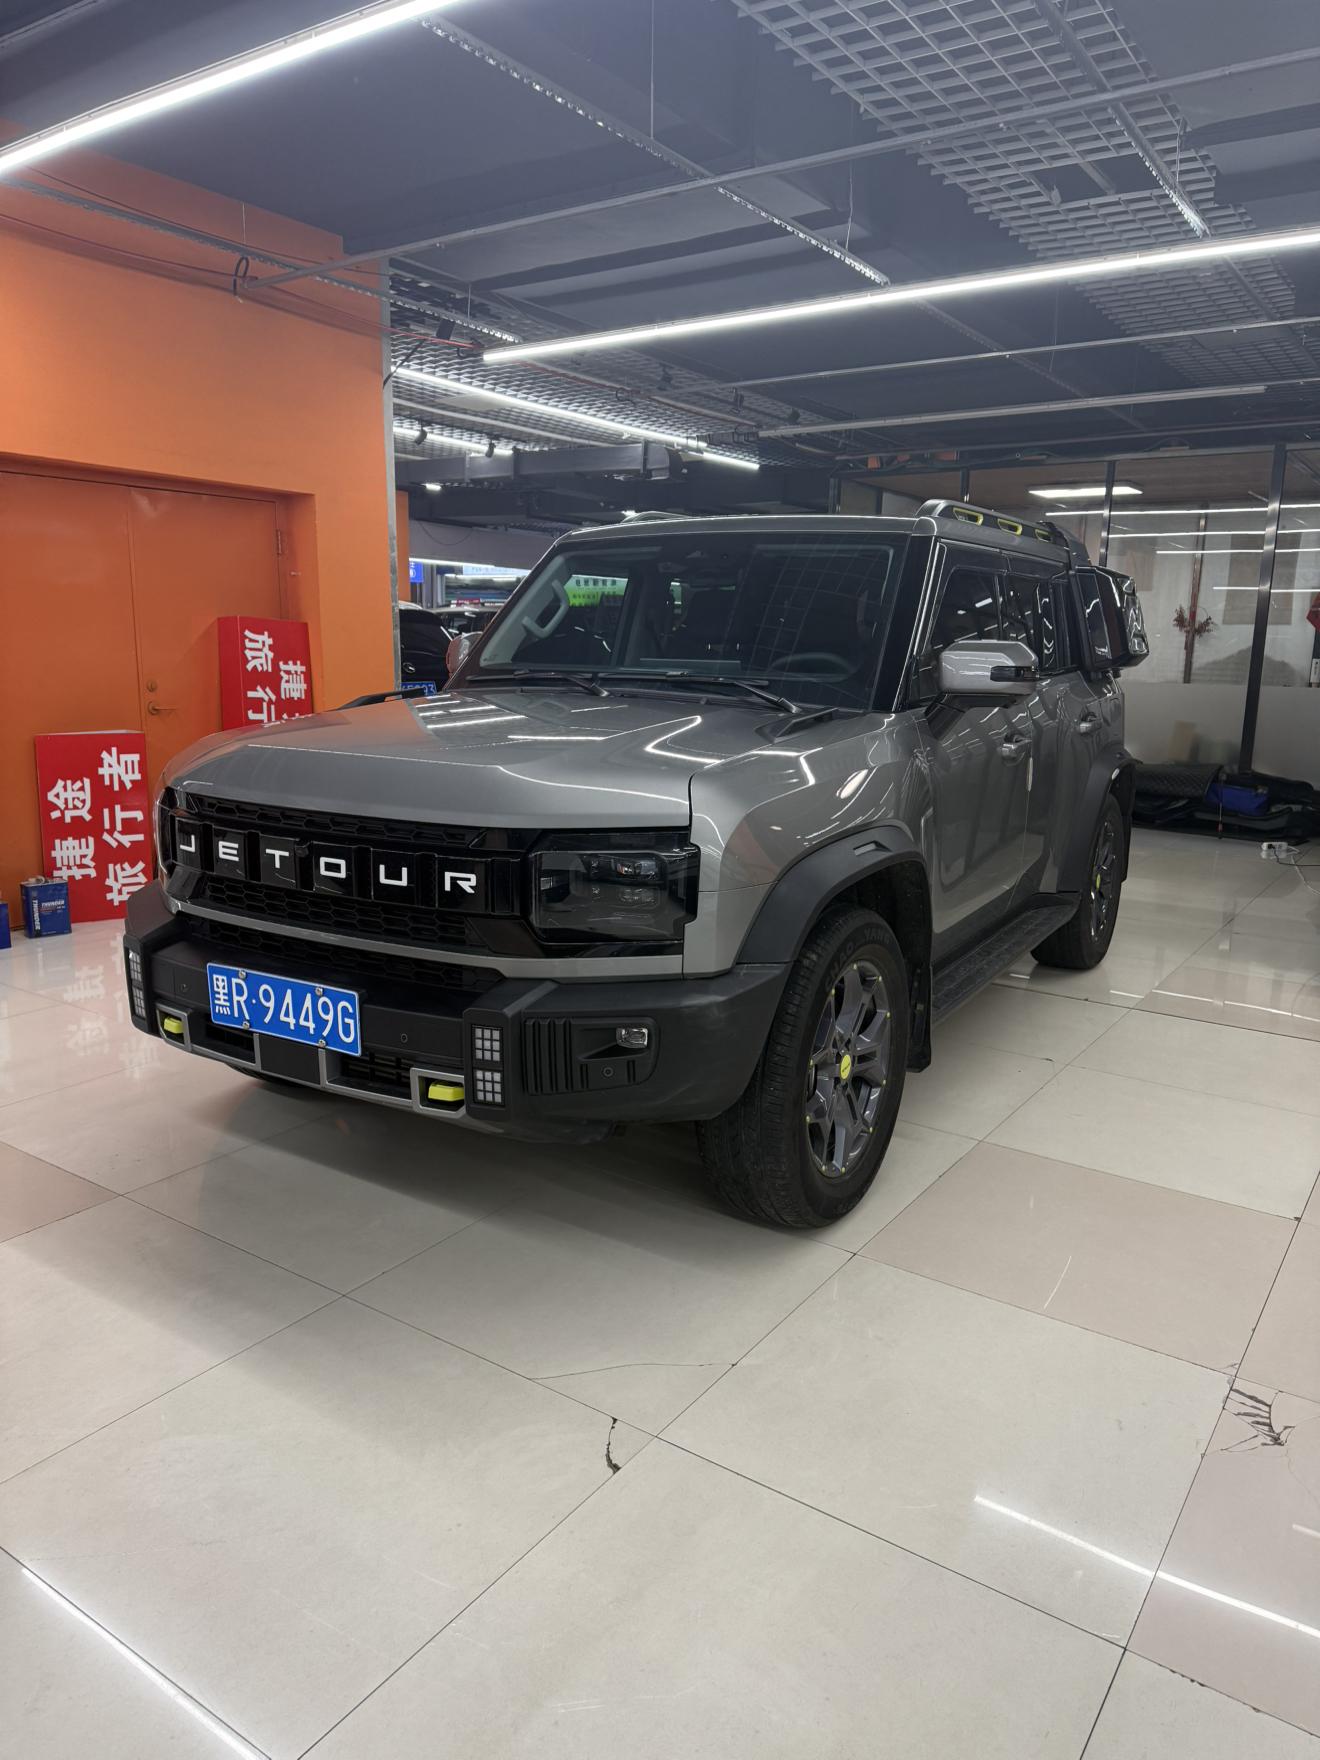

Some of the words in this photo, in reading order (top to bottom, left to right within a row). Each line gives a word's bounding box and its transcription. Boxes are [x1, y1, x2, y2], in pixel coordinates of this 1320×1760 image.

[47, 776, 97, 881] 捷途
[97, 746, 149, 907] 旅行者
[179, 834, 477, 894] JETOUR
[212, 973, 356, 1044] 黑R·9449G
